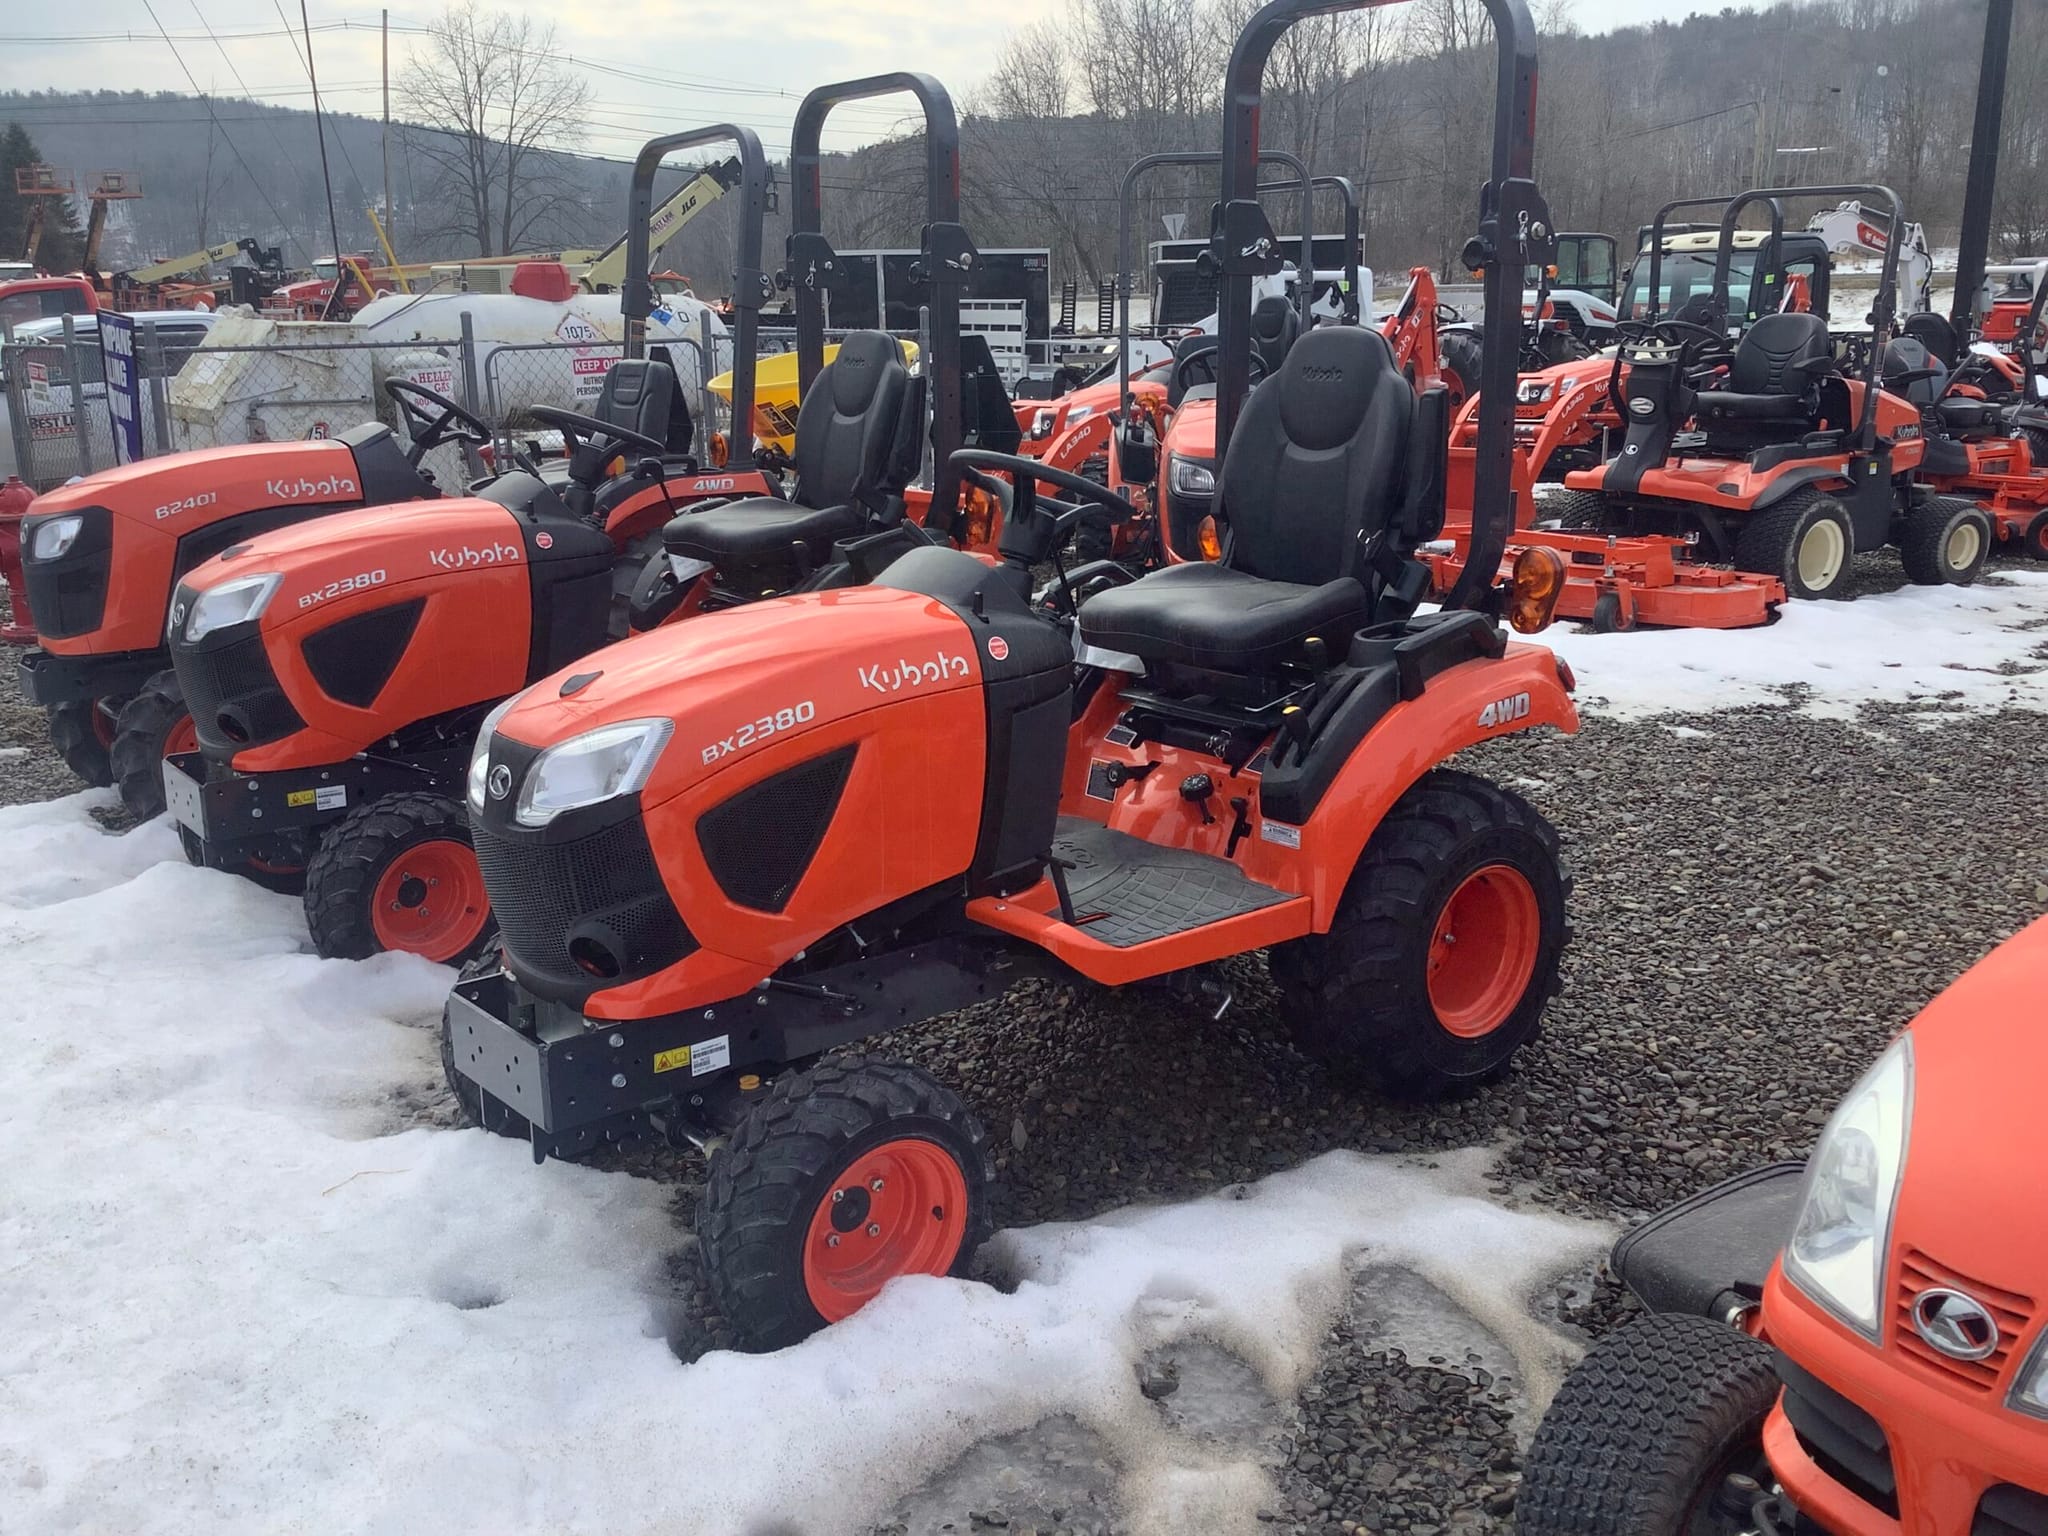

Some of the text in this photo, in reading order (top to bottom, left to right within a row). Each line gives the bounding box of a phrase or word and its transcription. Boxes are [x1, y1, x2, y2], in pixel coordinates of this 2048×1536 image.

[681, 195, 697, 216] JLG
[564, 325, 593, 339] 1075
[574, 359, 621, 373] KEEP OU
[583, 376, 606, 386] AUTHO
[266, 475, 356, 498] Kubota
[693, 478, 735, 491] 4WD
[155, 491, 217, 520] B2401
[430, 541, 519, 569] Kubota
[298, 568, 386, 609] BX2380
[858, 651, 969, 693] Kubota
[1477, 691, 1530, 729] 4WD
[701, 700, 816, 766] BX2380
